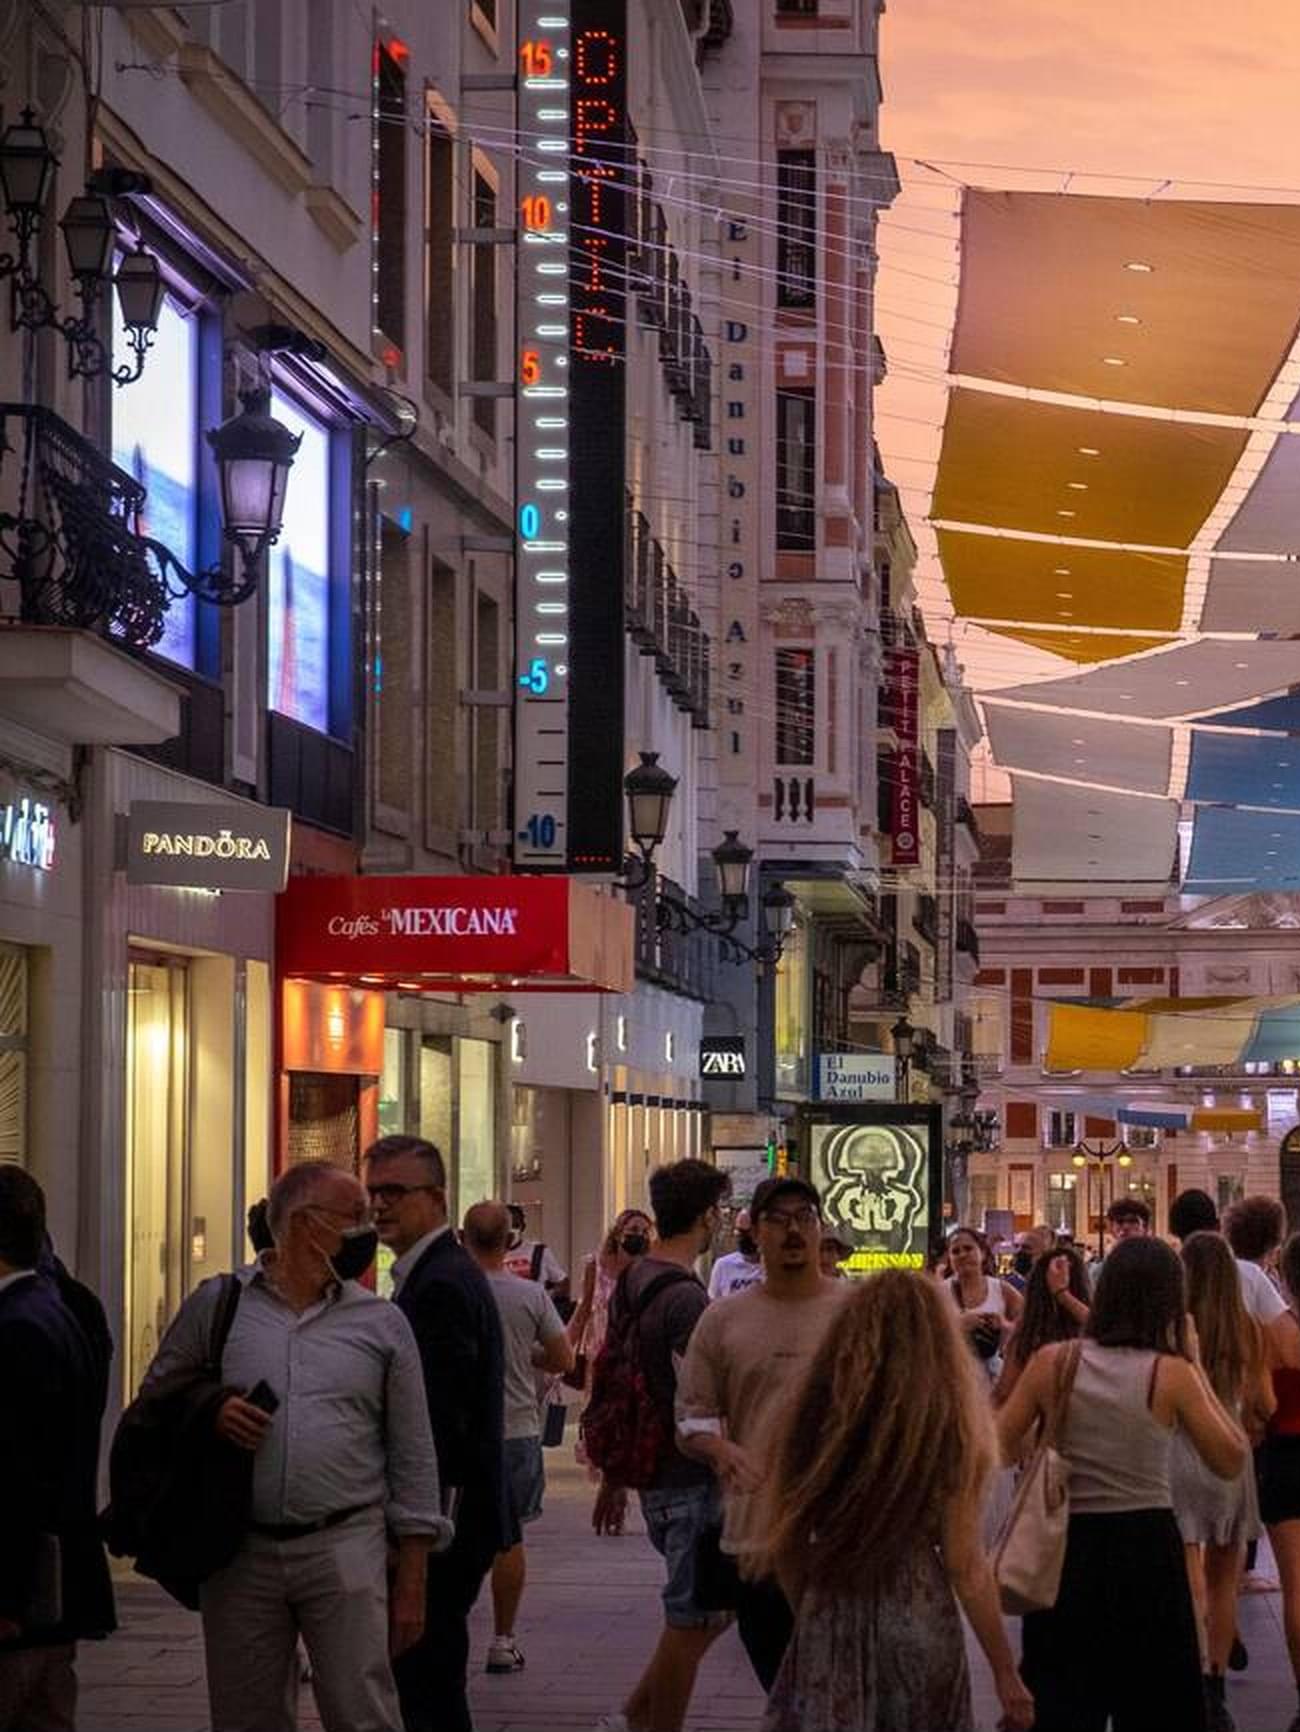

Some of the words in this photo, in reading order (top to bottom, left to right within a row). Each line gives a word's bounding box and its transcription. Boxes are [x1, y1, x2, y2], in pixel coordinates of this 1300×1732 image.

[520, 42, 552, 75] 15
[522, 195, 552, 229] 10
[522, 351, 541, 384] 5
[520, 504, 540, 539] 0
[518, 657, 547, 693] -5
[143, 830, 271, 860] PANDORA
[518, 814, 556, 849] -10
[328, 915, 379, 939] Cafés
[702, 1052, 745, 1074] ZARA
[827, 1056, 844, 1069] El
[827, 1071, 890, 1085] Danubio
